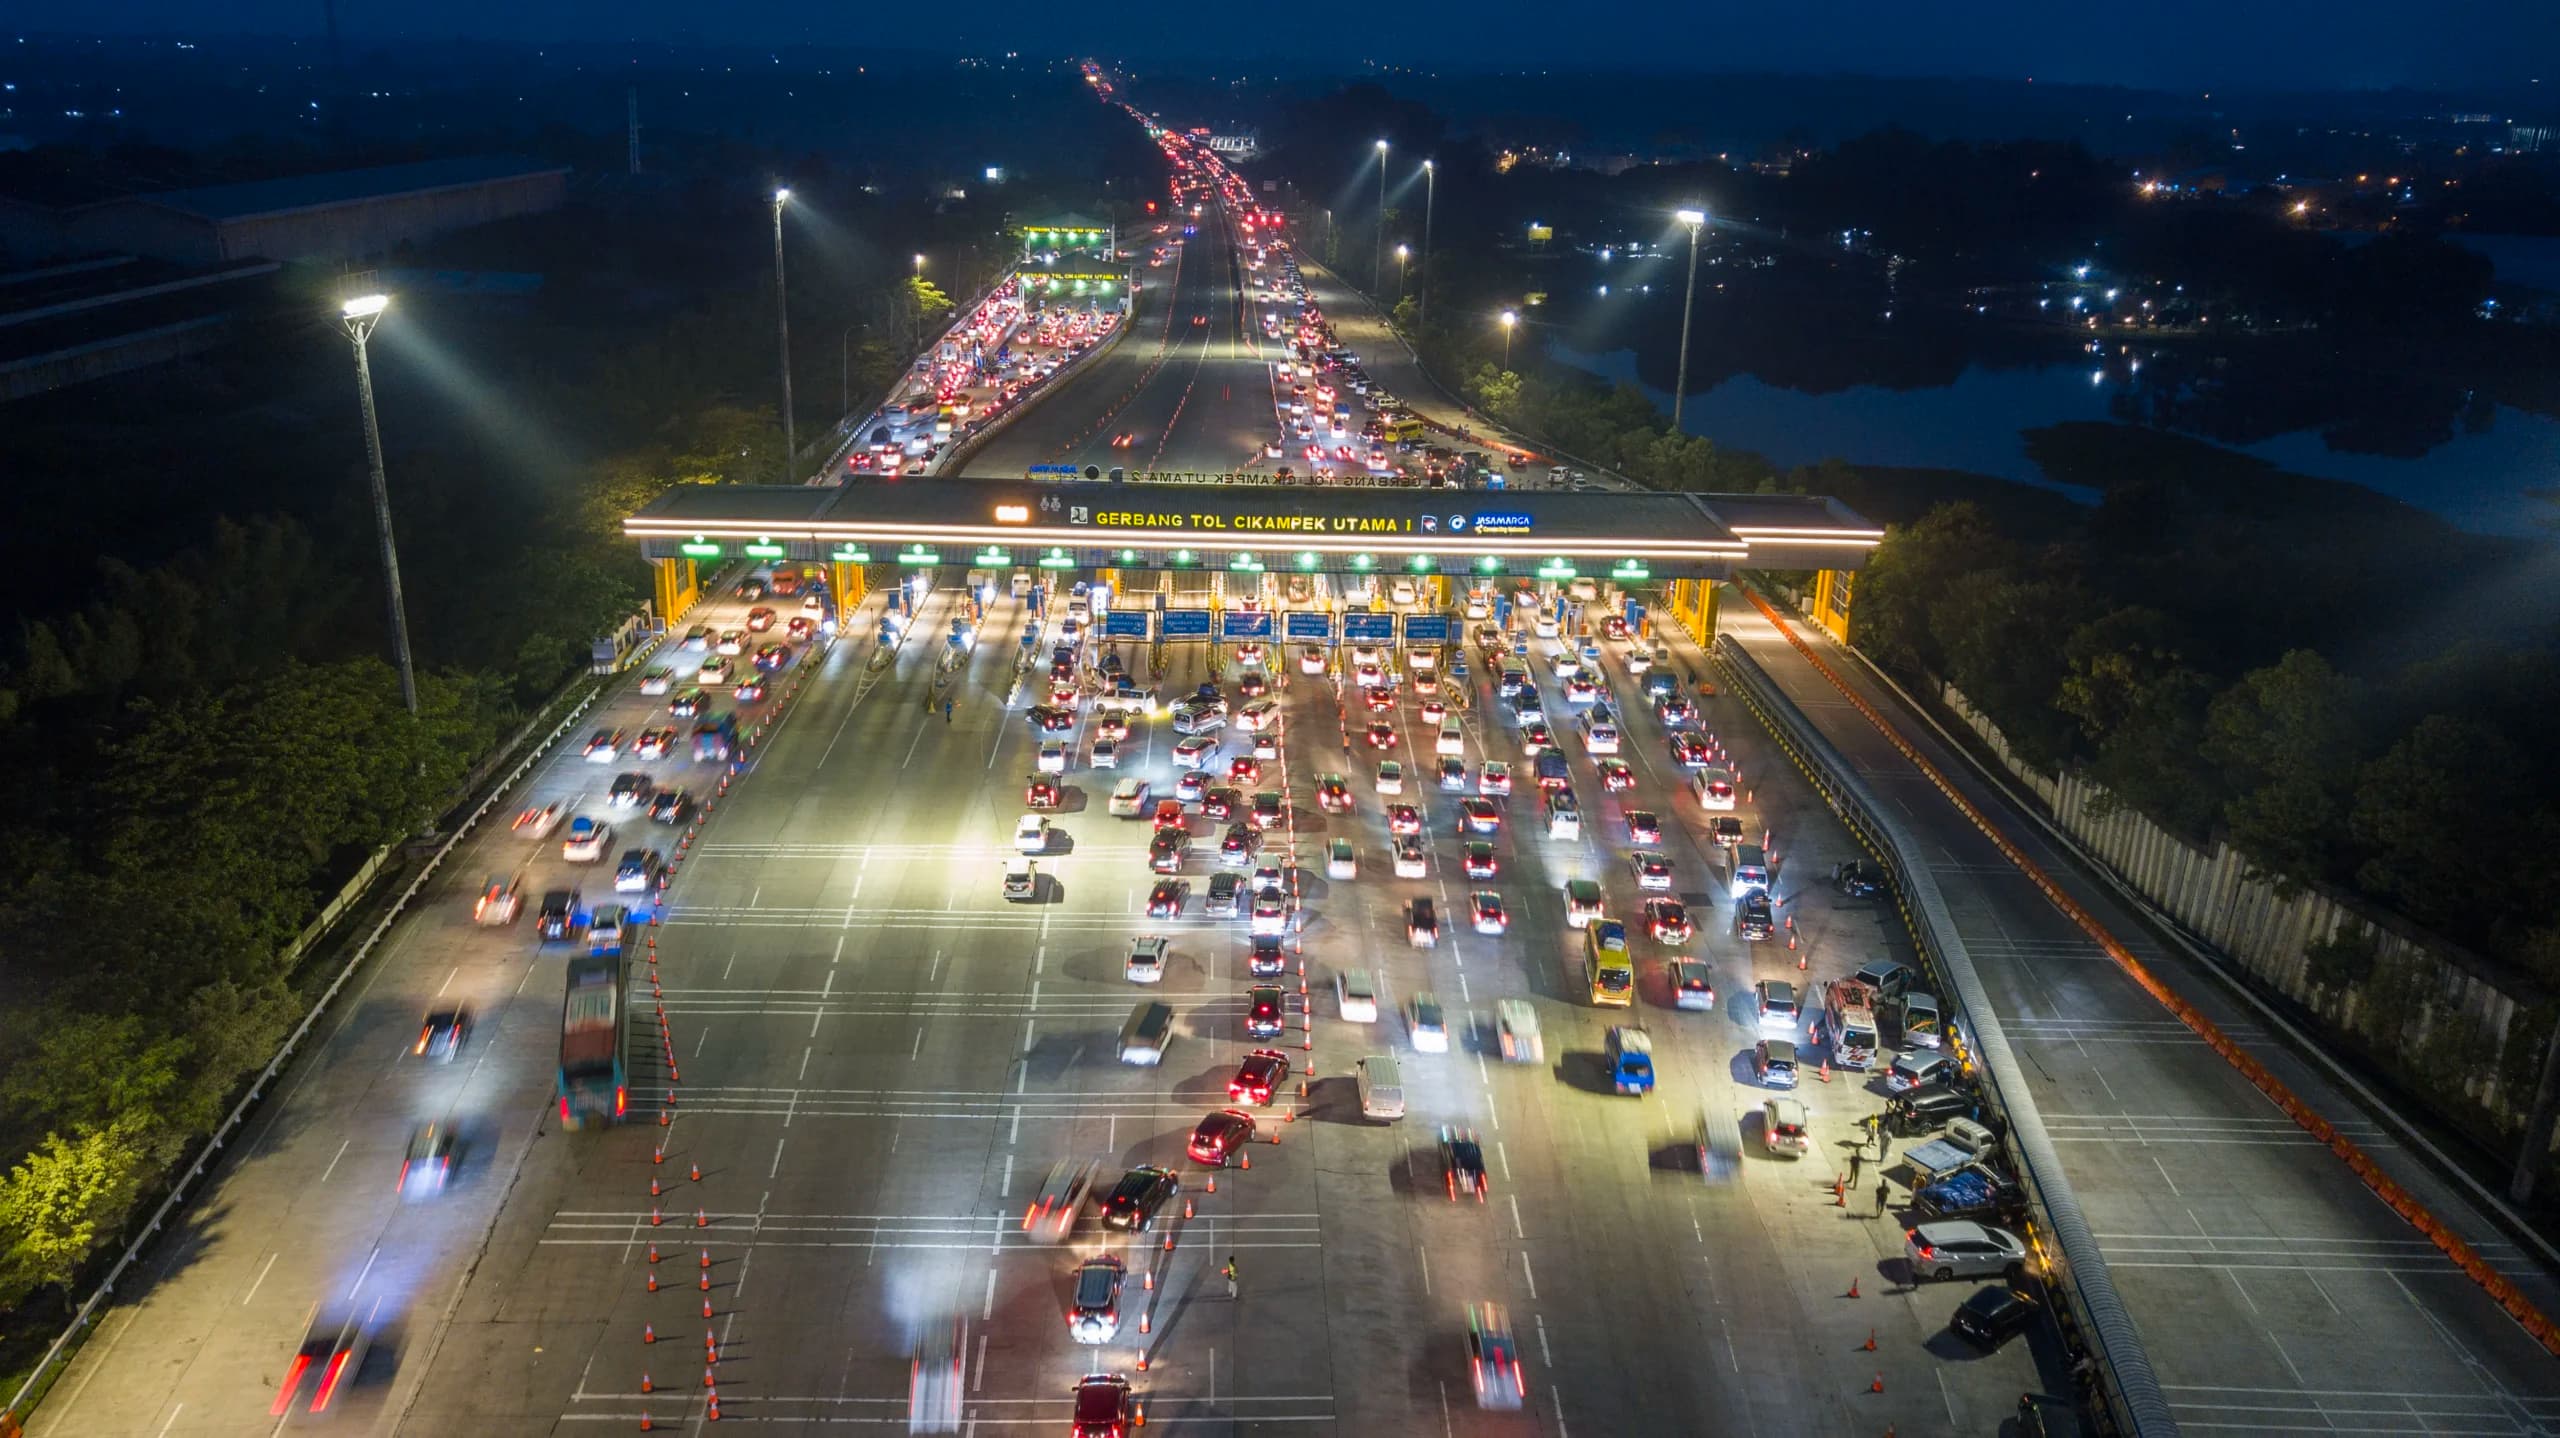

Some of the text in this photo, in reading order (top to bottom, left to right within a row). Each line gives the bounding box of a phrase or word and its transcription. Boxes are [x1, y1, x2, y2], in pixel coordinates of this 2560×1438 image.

[1096, 512, 1183, 527] GERBANG
[1190, 514, 1226, 528] TOL
[1234, 515, 1326, 531] CIKAMPEK
[1333, 517, 1397, 532] UTAMA
